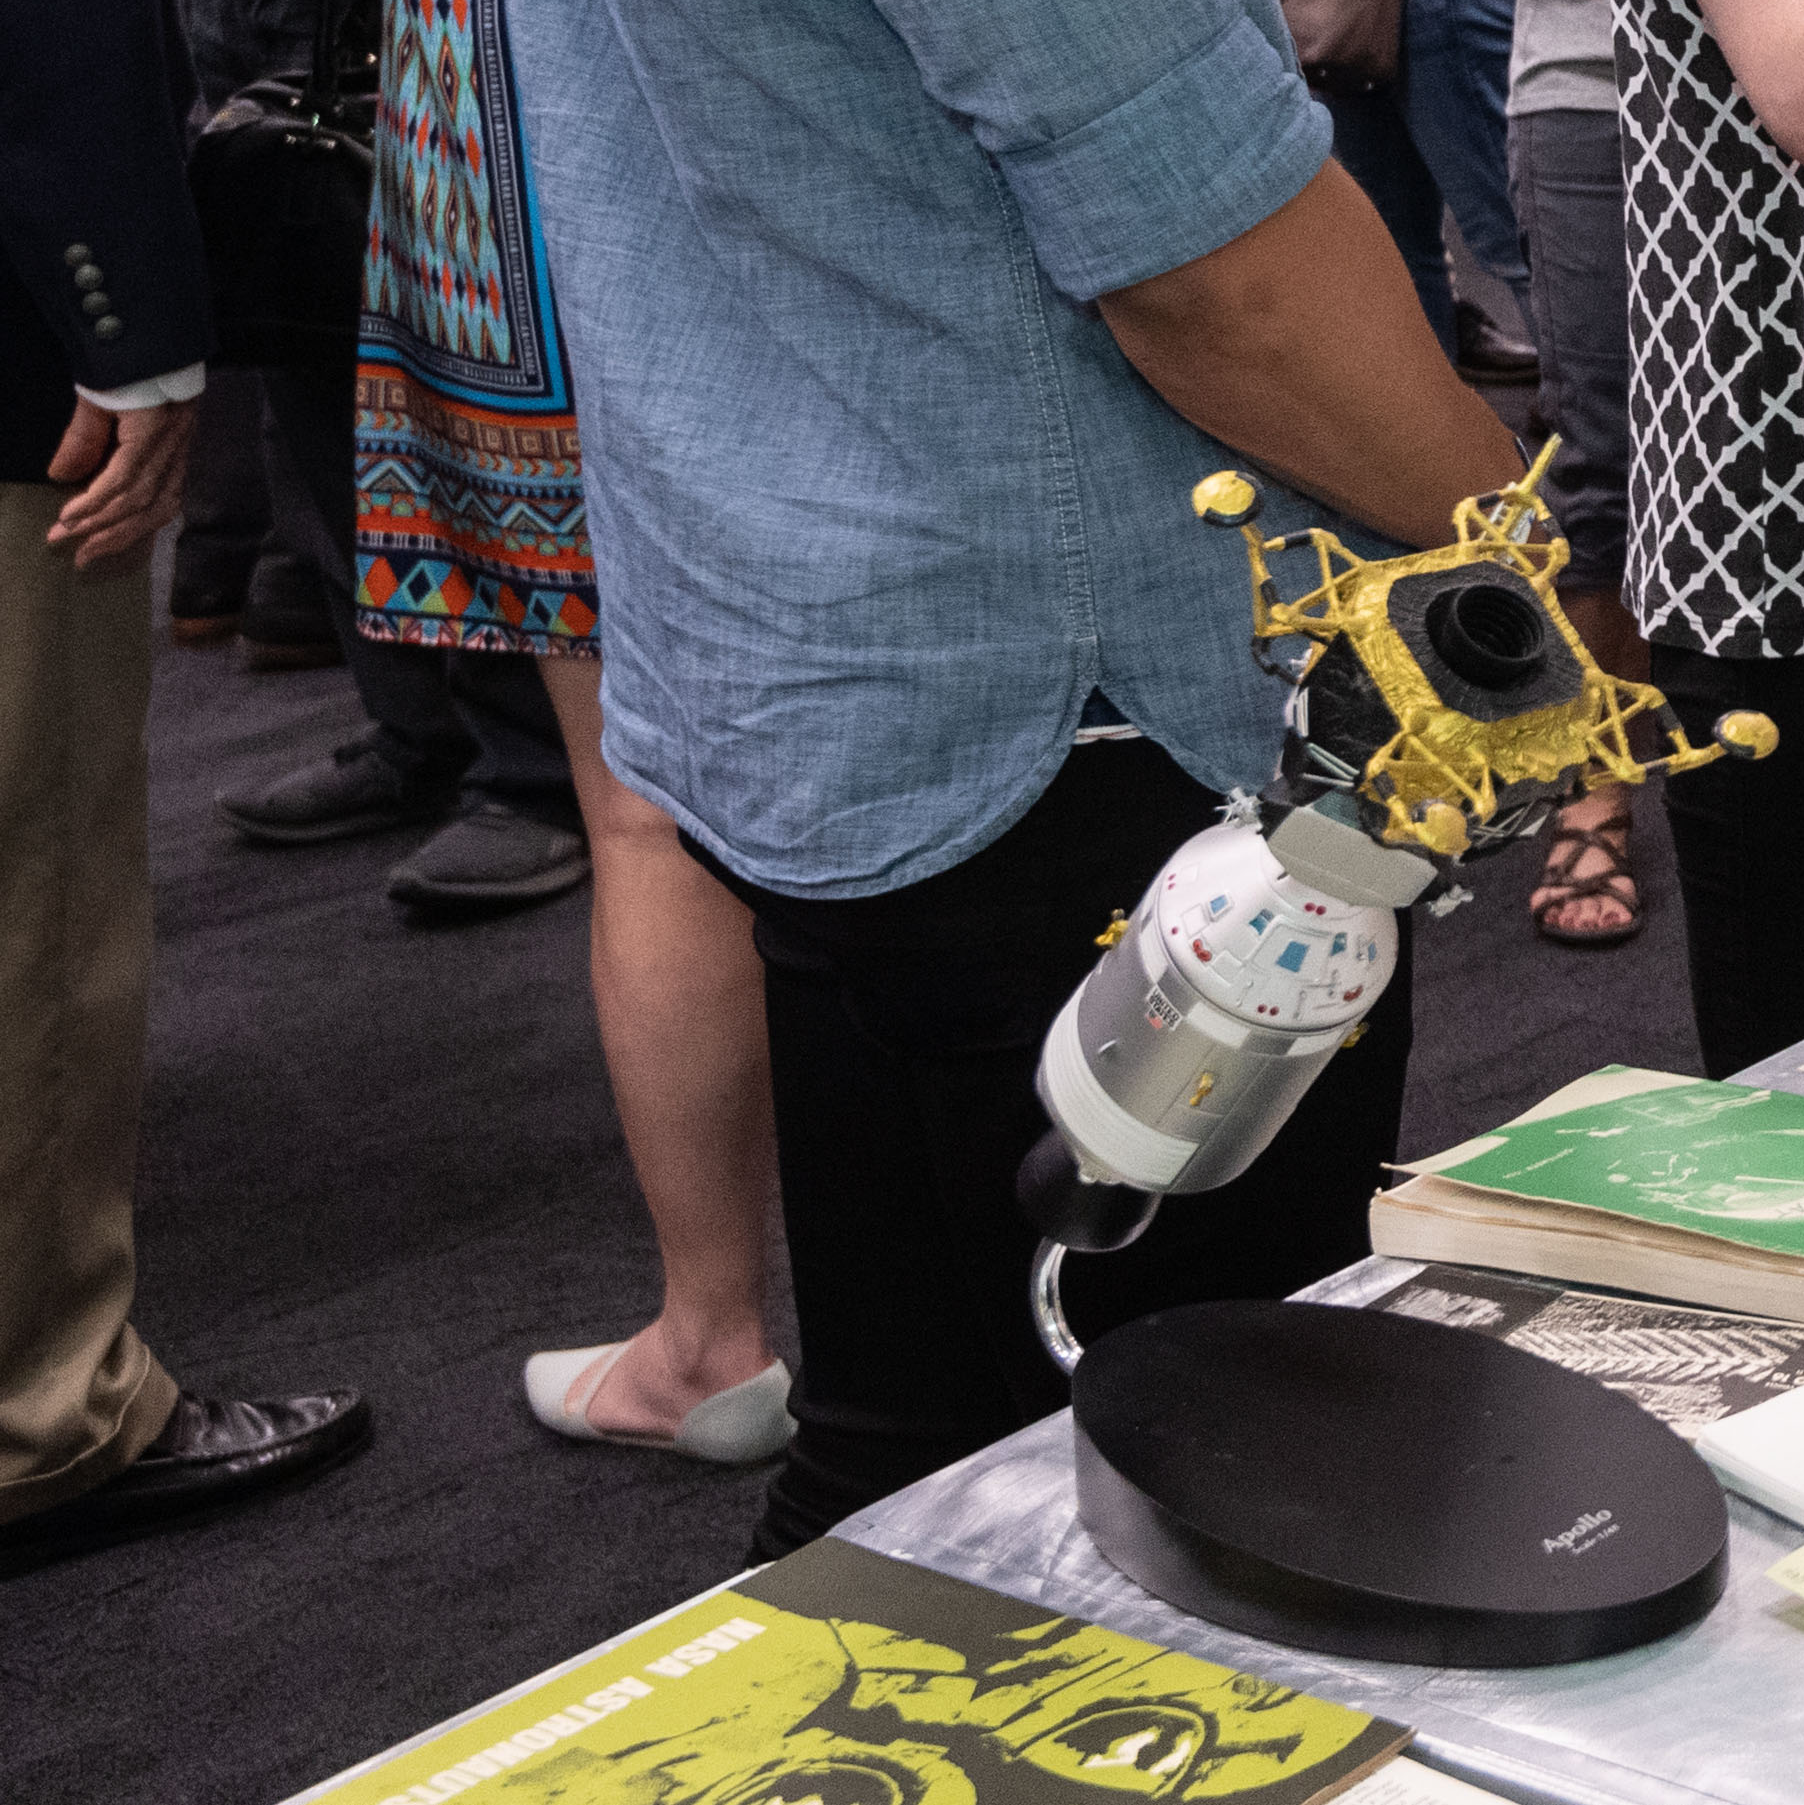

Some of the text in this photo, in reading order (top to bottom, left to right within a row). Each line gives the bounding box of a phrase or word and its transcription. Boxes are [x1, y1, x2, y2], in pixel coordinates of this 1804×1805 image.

[1149, 996, 1174, 1028] STATES
[1152, 988, 1180, 1021] UNITED
[1541, 1509, 1612, 1554] Apollo
[644, 1616, 767, 1679] NASA
